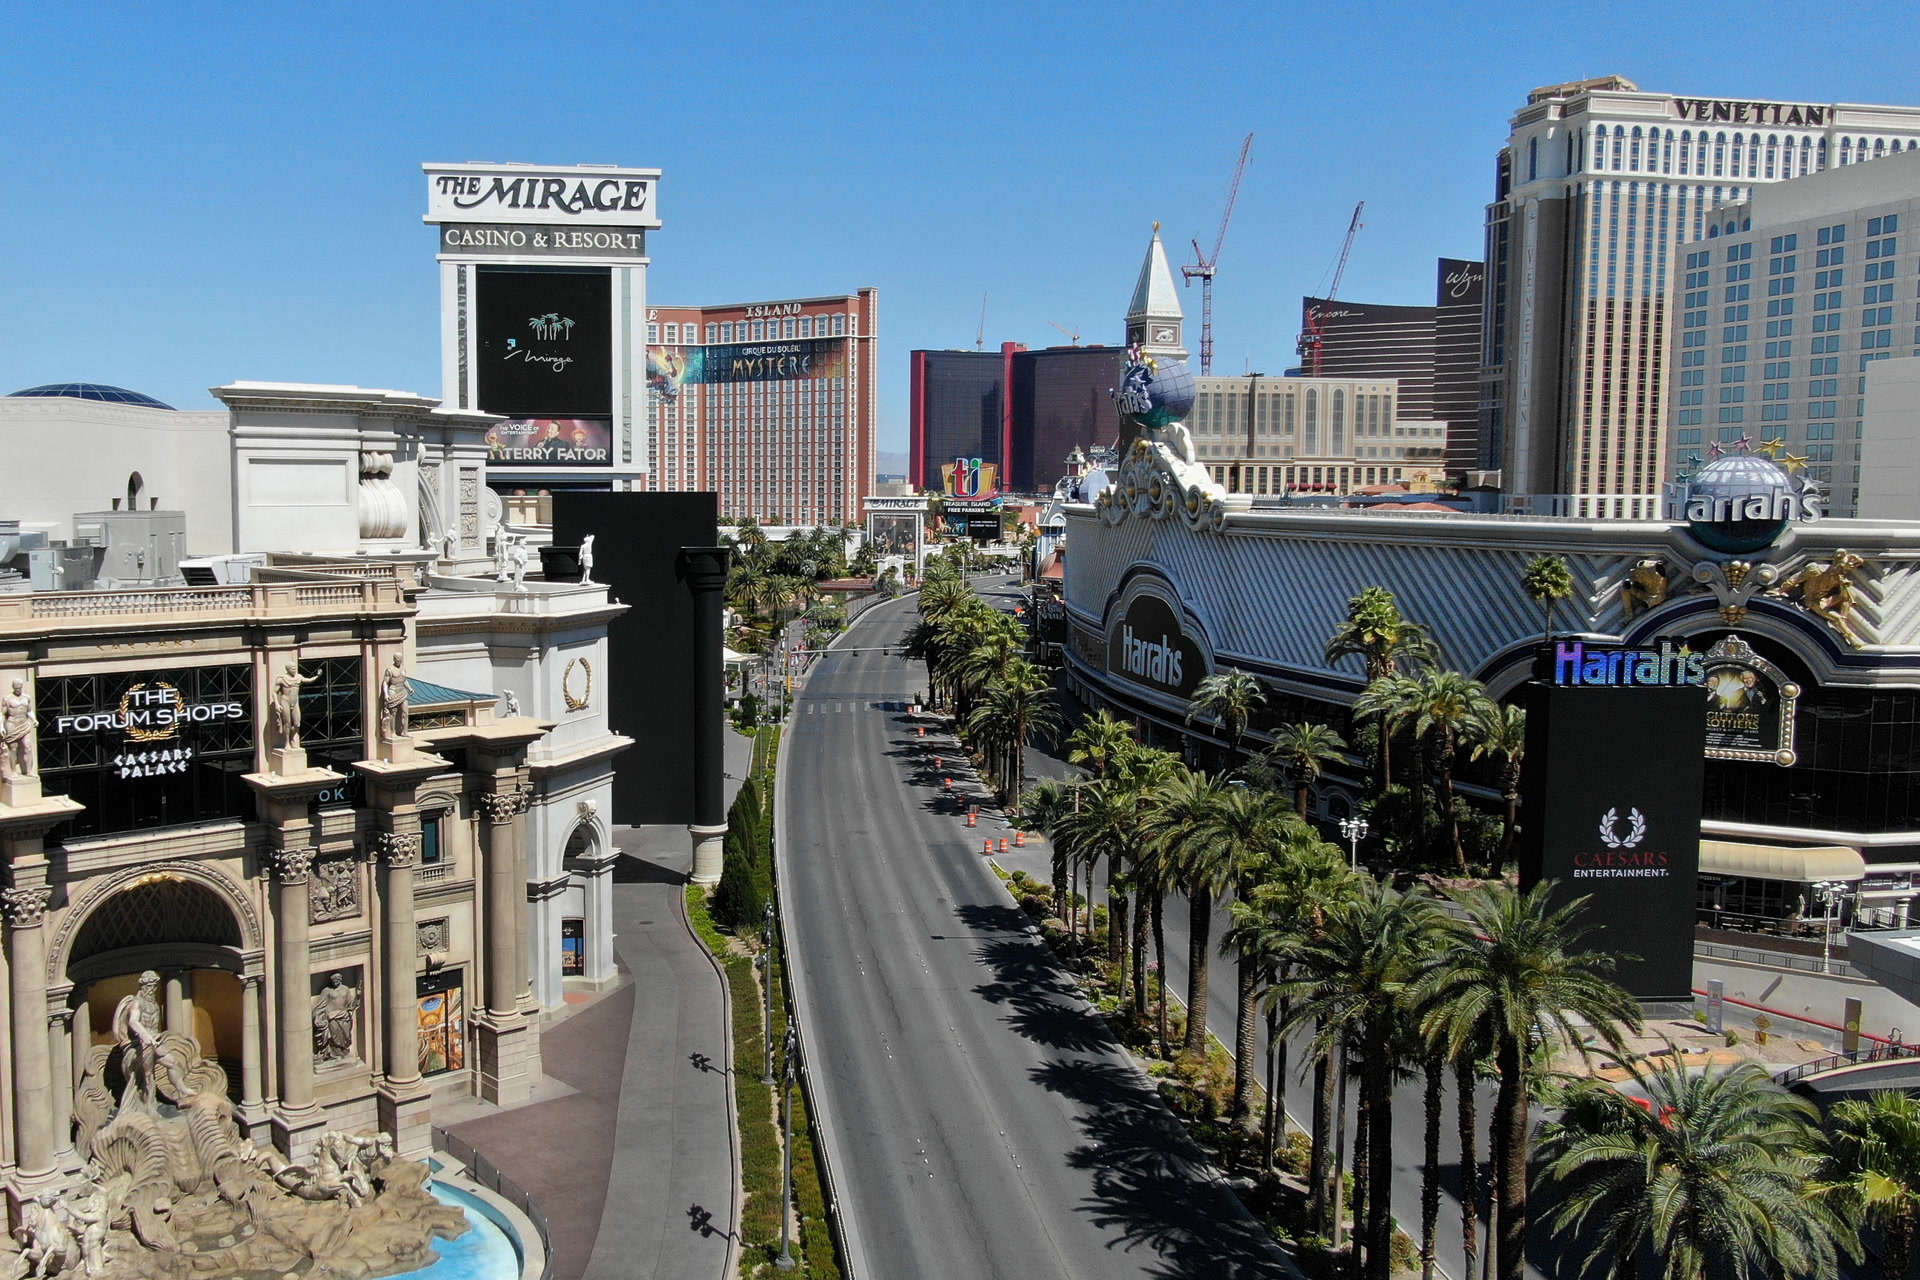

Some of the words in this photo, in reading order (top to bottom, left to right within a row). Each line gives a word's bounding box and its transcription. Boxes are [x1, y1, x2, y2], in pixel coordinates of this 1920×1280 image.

[1673, 99, 1824, 126] VENETIAN
[436, 176, 481, 195] THE
[454, 177, 647, 214] MIRAGE
[445, 229, 526, 247] CASINO
[533, 232, 548, 247] &
[554, 232, 641, 250] RESORT
[745, 303, 802, 318] ISLAND
[1308, 305, 1365, 320] Encore
[742, 348, 766, 356] CIRQUE
[778, 344, 801, 353] SOLEIL
[503, 447, 554, 460] TERRY
[557, 448, 607, 460] FATOR
[880, 500, 920, 508] MIRAGE
[129, 688, 178, 707] THE
[58, 710, 150, 734] FORUM
[156, 703, 243, 725] SHOPS
[114, 747, 193, 767] CAESARS
[121, 760, 187, 779] PALACE
[1574, 851, 1668, 867] CAESARS
[1574, 868, 1667, 878] ENTERTAINMENT
